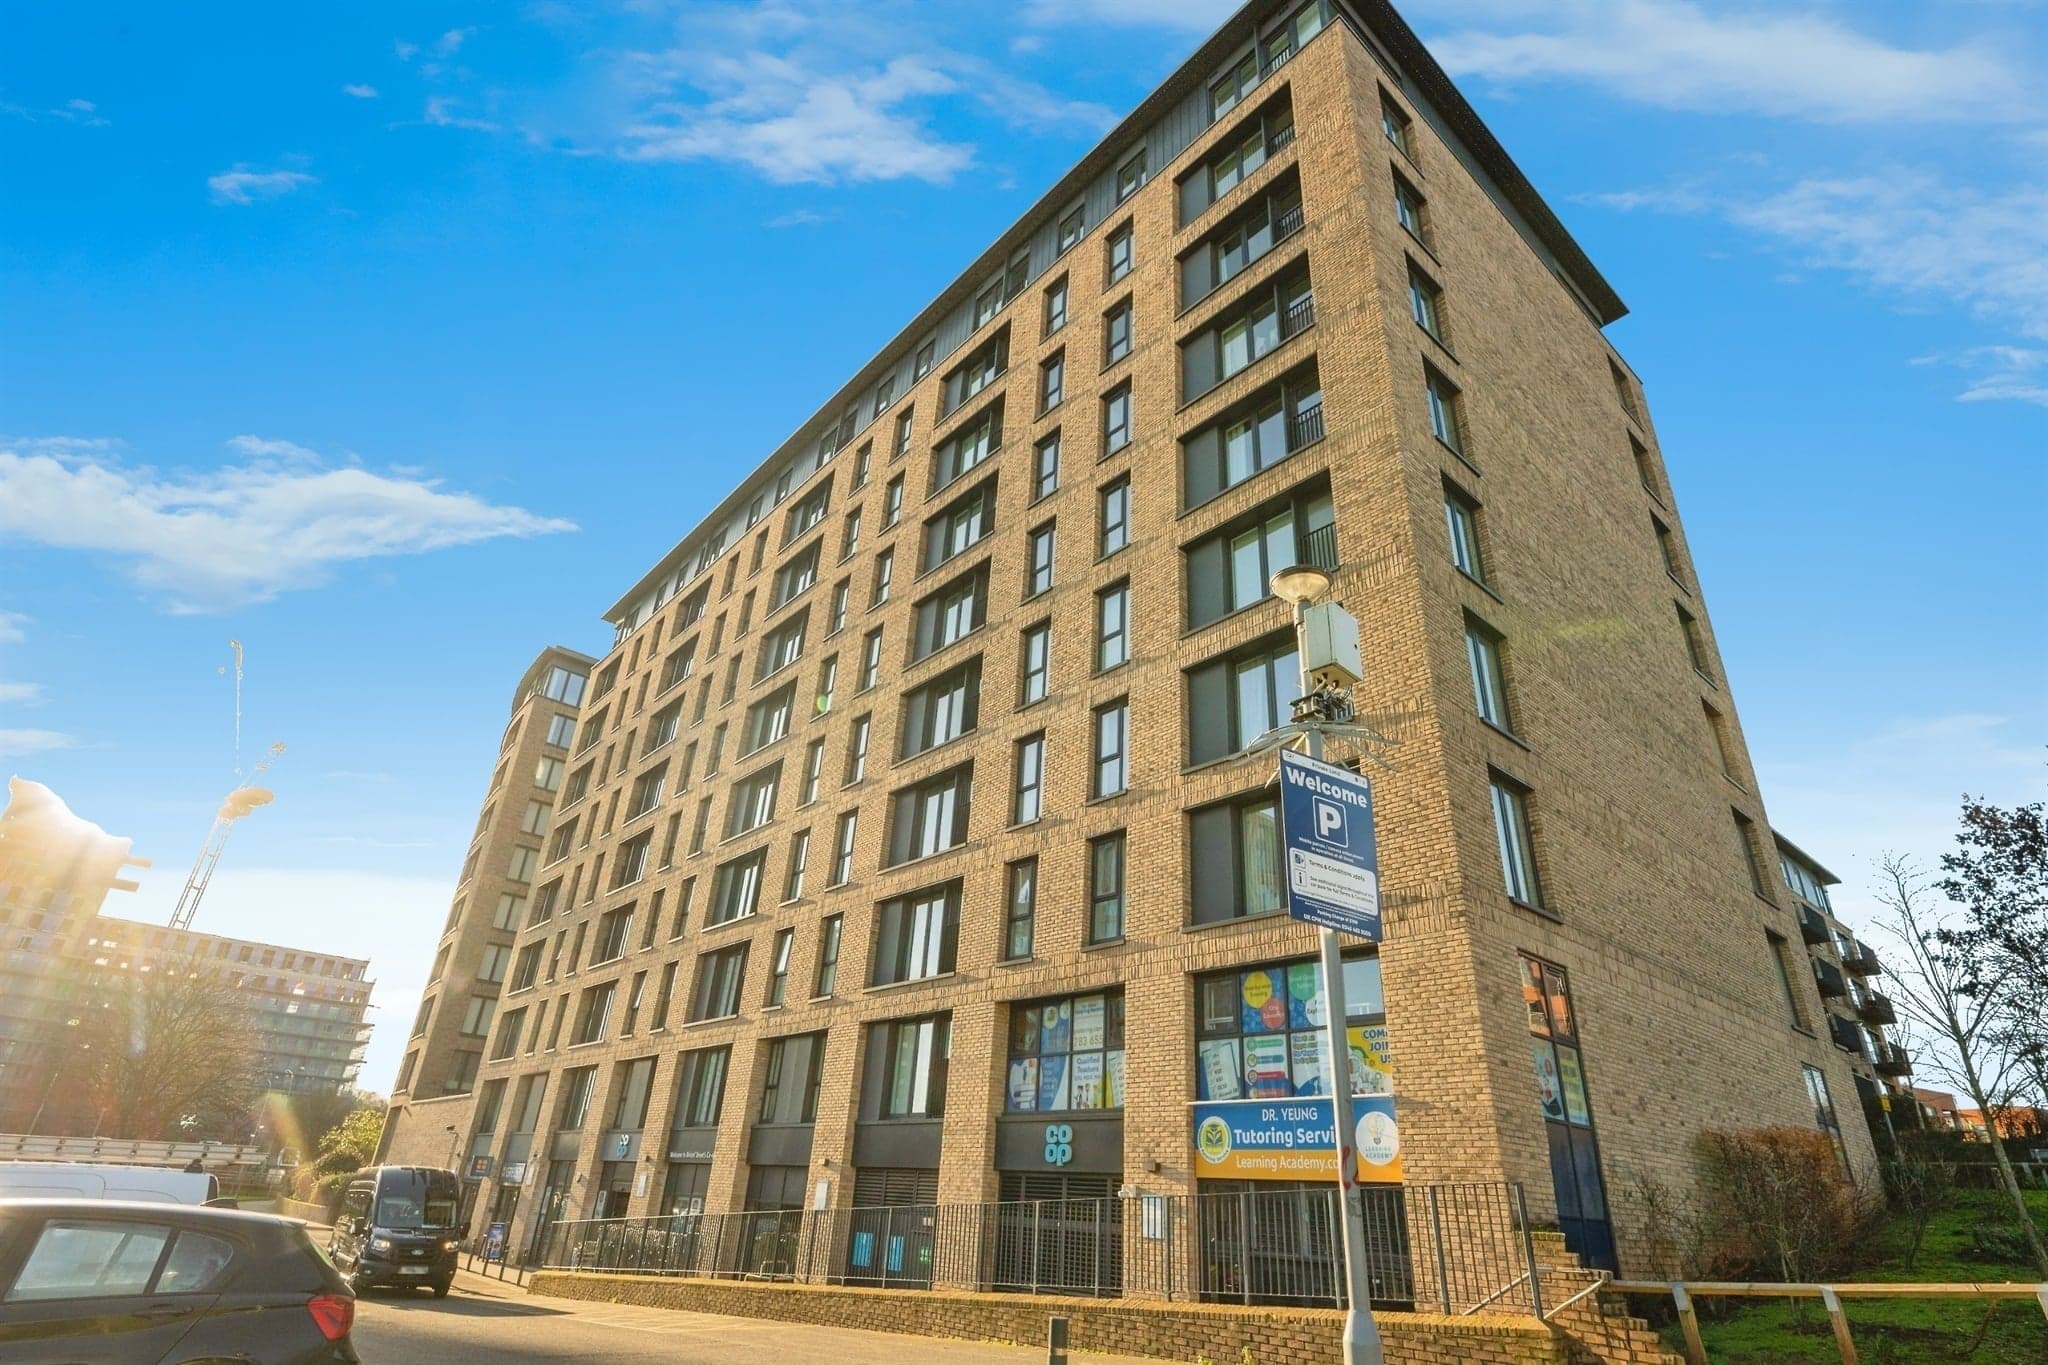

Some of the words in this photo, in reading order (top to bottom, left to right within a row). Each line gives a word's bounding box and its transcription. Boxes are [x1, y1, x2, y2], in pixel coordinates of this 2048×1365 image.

[1286, 765, 1368, 808] Welcome
[1318, 803, 1342, 837] P
[1262, 1108, 1279, 1121] DR.
[1281, 1107, 1318, 1120] YEUNG
[1234, 1126, 1293, 1147] Tutoring
[1296, 1124, 1336, 1144] Servi
[1236, 1155, 1277, 1172] Learning
[1279, 1155, 1339, 1172] Academy.co
